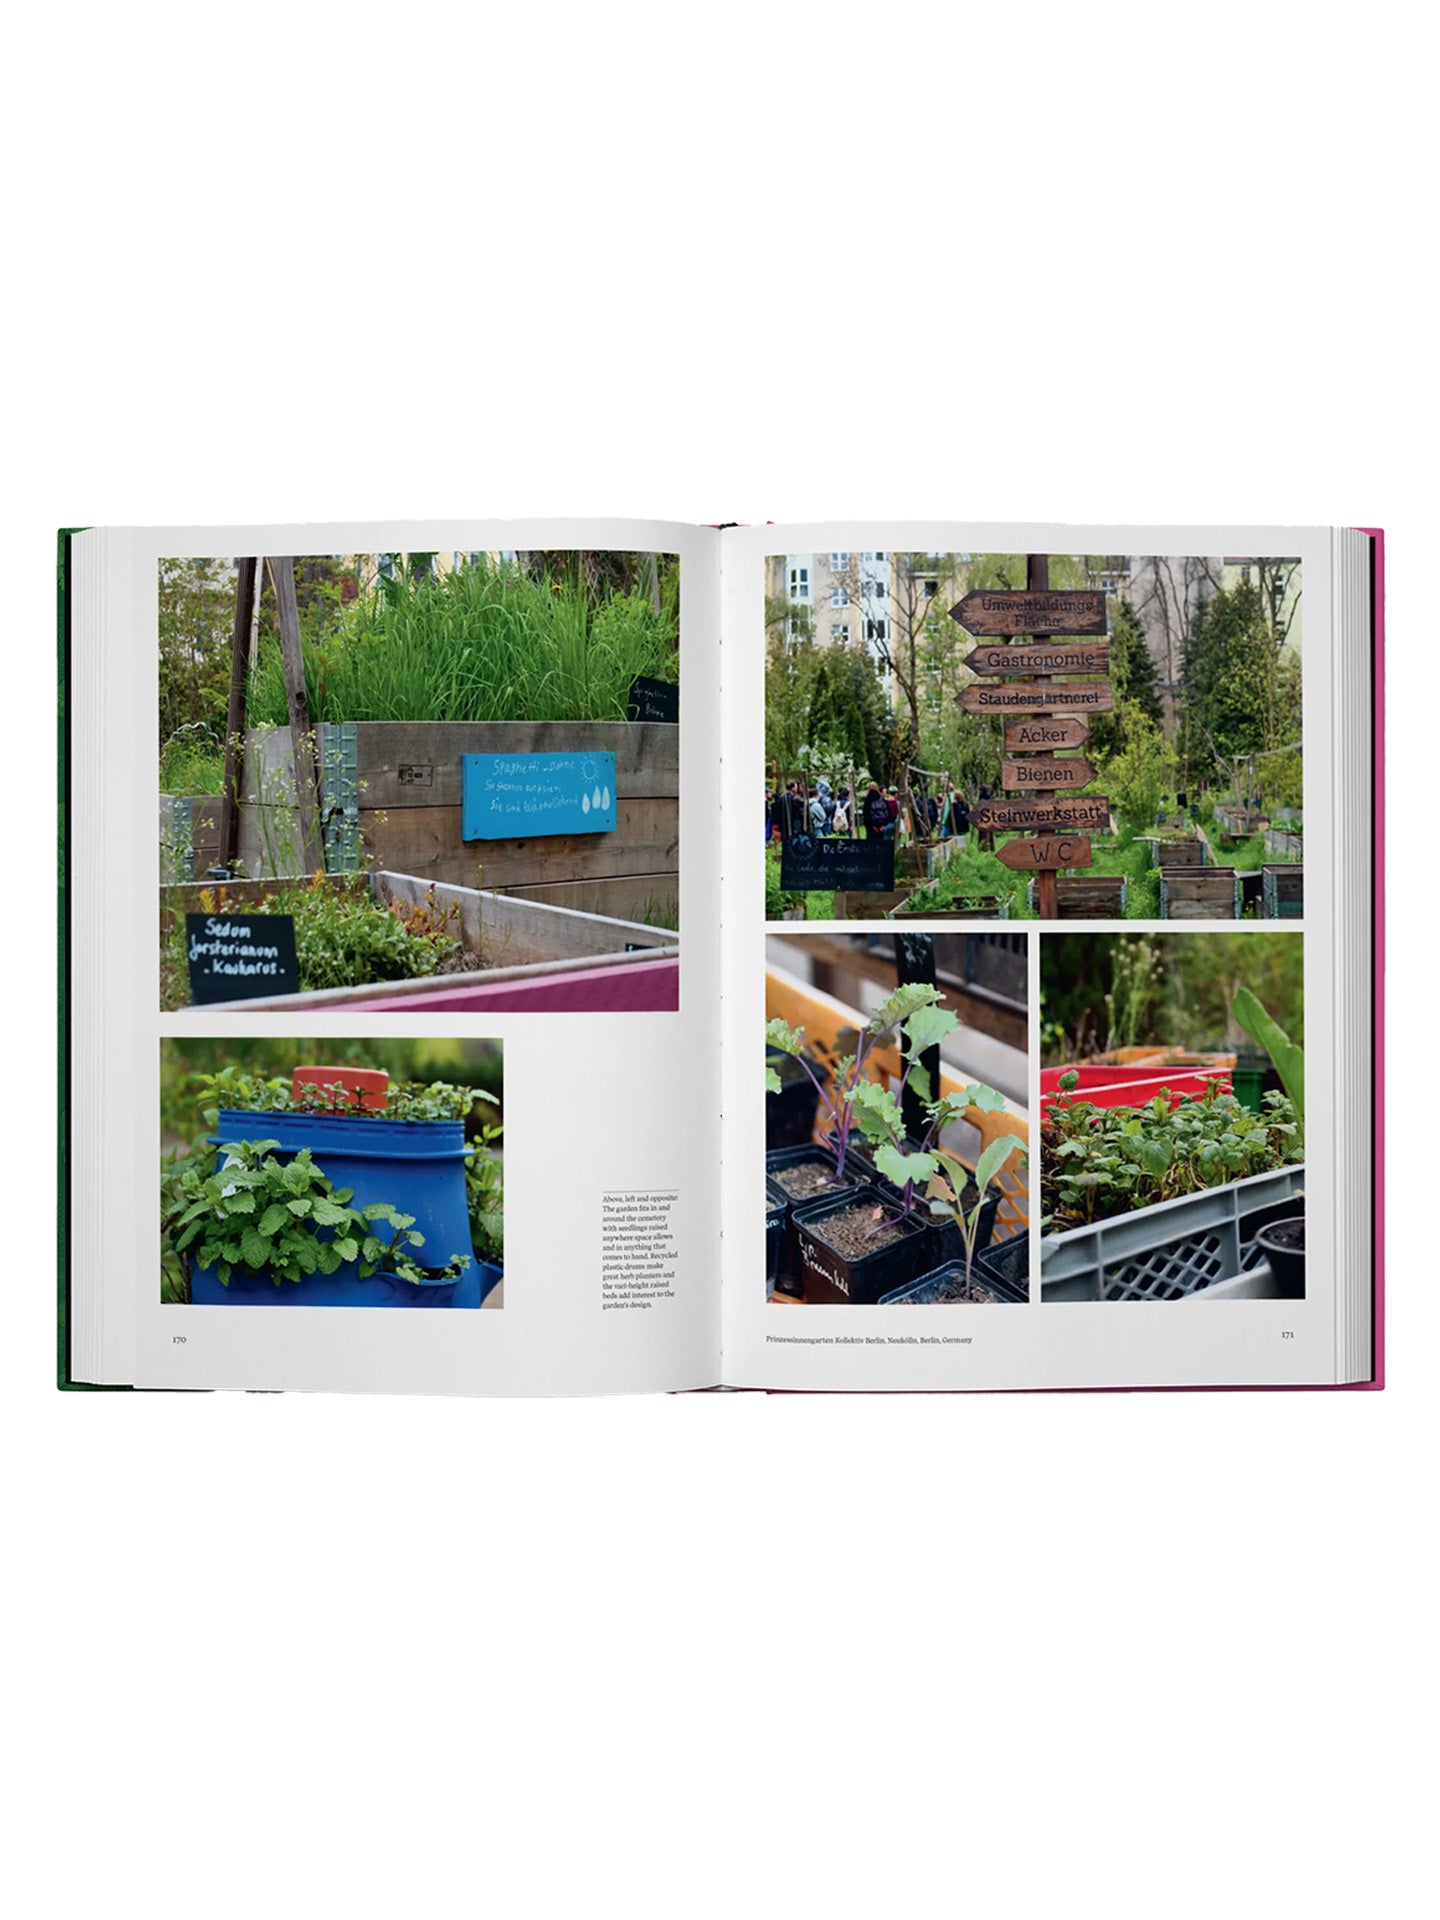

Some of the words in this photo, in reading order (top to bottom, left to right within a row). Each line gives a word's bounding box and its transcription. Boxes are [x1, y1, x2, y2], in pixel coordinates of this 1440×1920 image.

[987, 652, 1095, 668] Gastronomie
[1019, 728, 1068, 743] Acker
[492, 759, 540, 776] Spaghetti
[1017, 766, 1074, 782] Bienen
[979, 808, 1101, 824] Steinwerkstatt
[616, 1205, 638, 1213] garden
[618, 1224, 648, 1232] seedlings
[624, 1244, 652, 1252] anything
[650, 1252, 678, 1260] Recycled
[602, 1263, 623, 1272] plastic
[636, 1272, 662, 1280] planters
[614, 1281, 649, 1290] vari-height
[602, 1301, 628, 1310] garden's
[172, 1336, 187, 1344] 170
[766, 1336, 834, 1344] Prinzessinnengarten
[1282, 1332, 1294, 1340] 171
